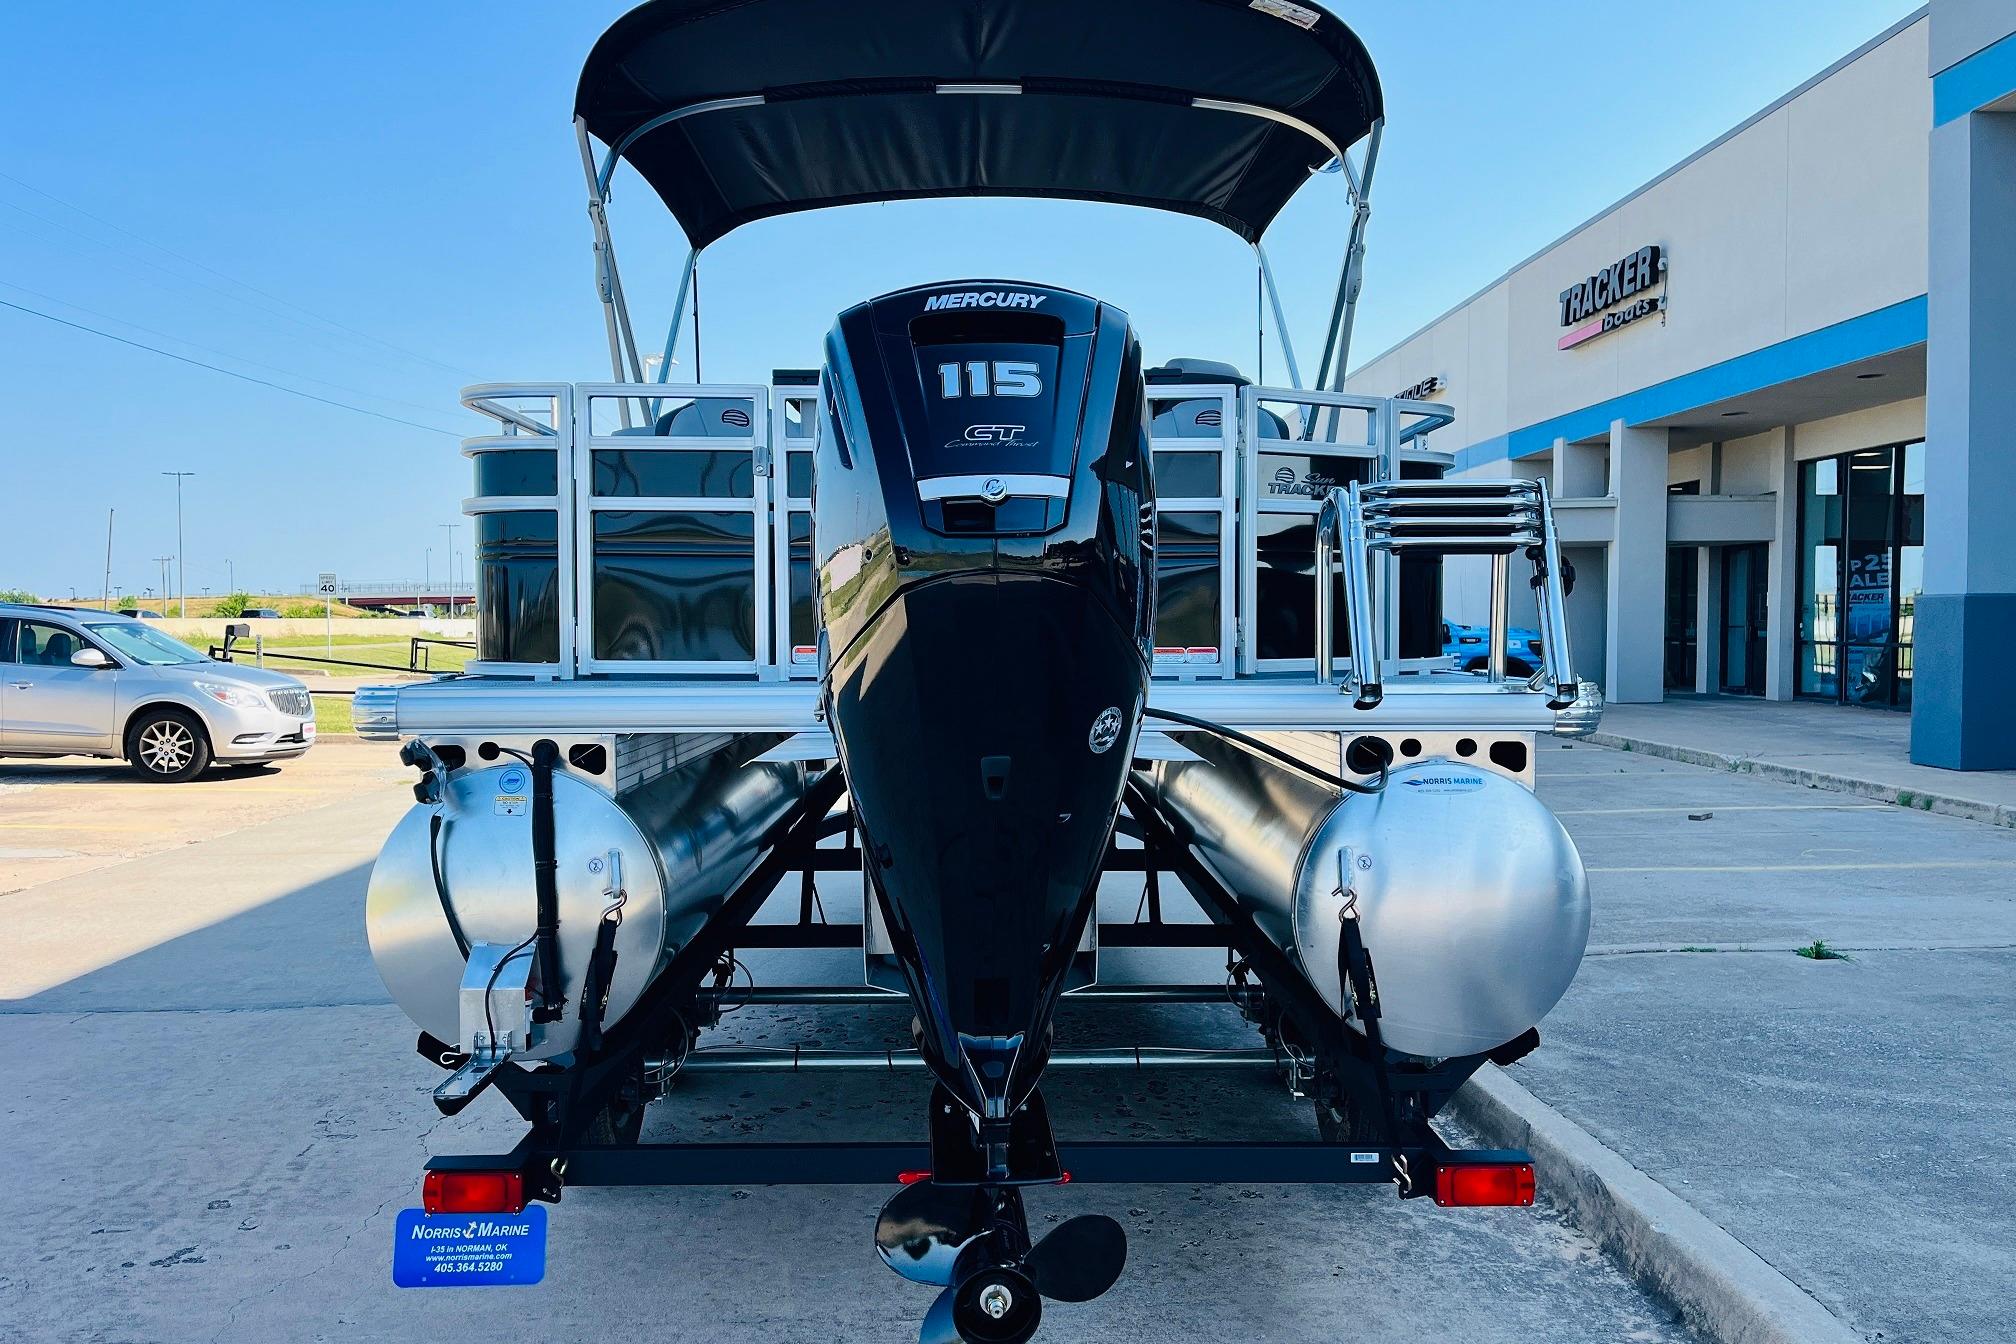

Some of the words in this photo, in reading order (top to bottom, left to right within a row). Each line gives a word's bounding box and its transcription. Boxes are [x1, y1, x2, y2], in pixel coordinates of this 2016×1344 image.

[1560, 246, 1655, 326] TRACKER
[923, 292, 1047, 311] MERCURY
[1603, 299, 1653, 331] boats
[938, 361, 1043, 398] 115
[964, 424, 1026, 441] GT
[1301, 472, 1336, 484] Sun
[1268, 483, 1340, 495] TRACK
[321, 584, 335, 592] 40
[1850, 593, 1885, 601] ACKER
[1453, 777, 1483, 785] MARINE
[411, 1224, 461, 1240] NORRIS
[477, 1222, 530, 1237] MARINE
[430, 1245, 446, 1254] I-35
[446, 1245, 454, 1253] in
[455, 1243, 493, 1254] NORMAN,
[495, 1243, 508, 1252] OK
[425, 1252, 513, 1262] www.norrismarine.com
[433, 1261, 503, 1273] 405.364.5280
